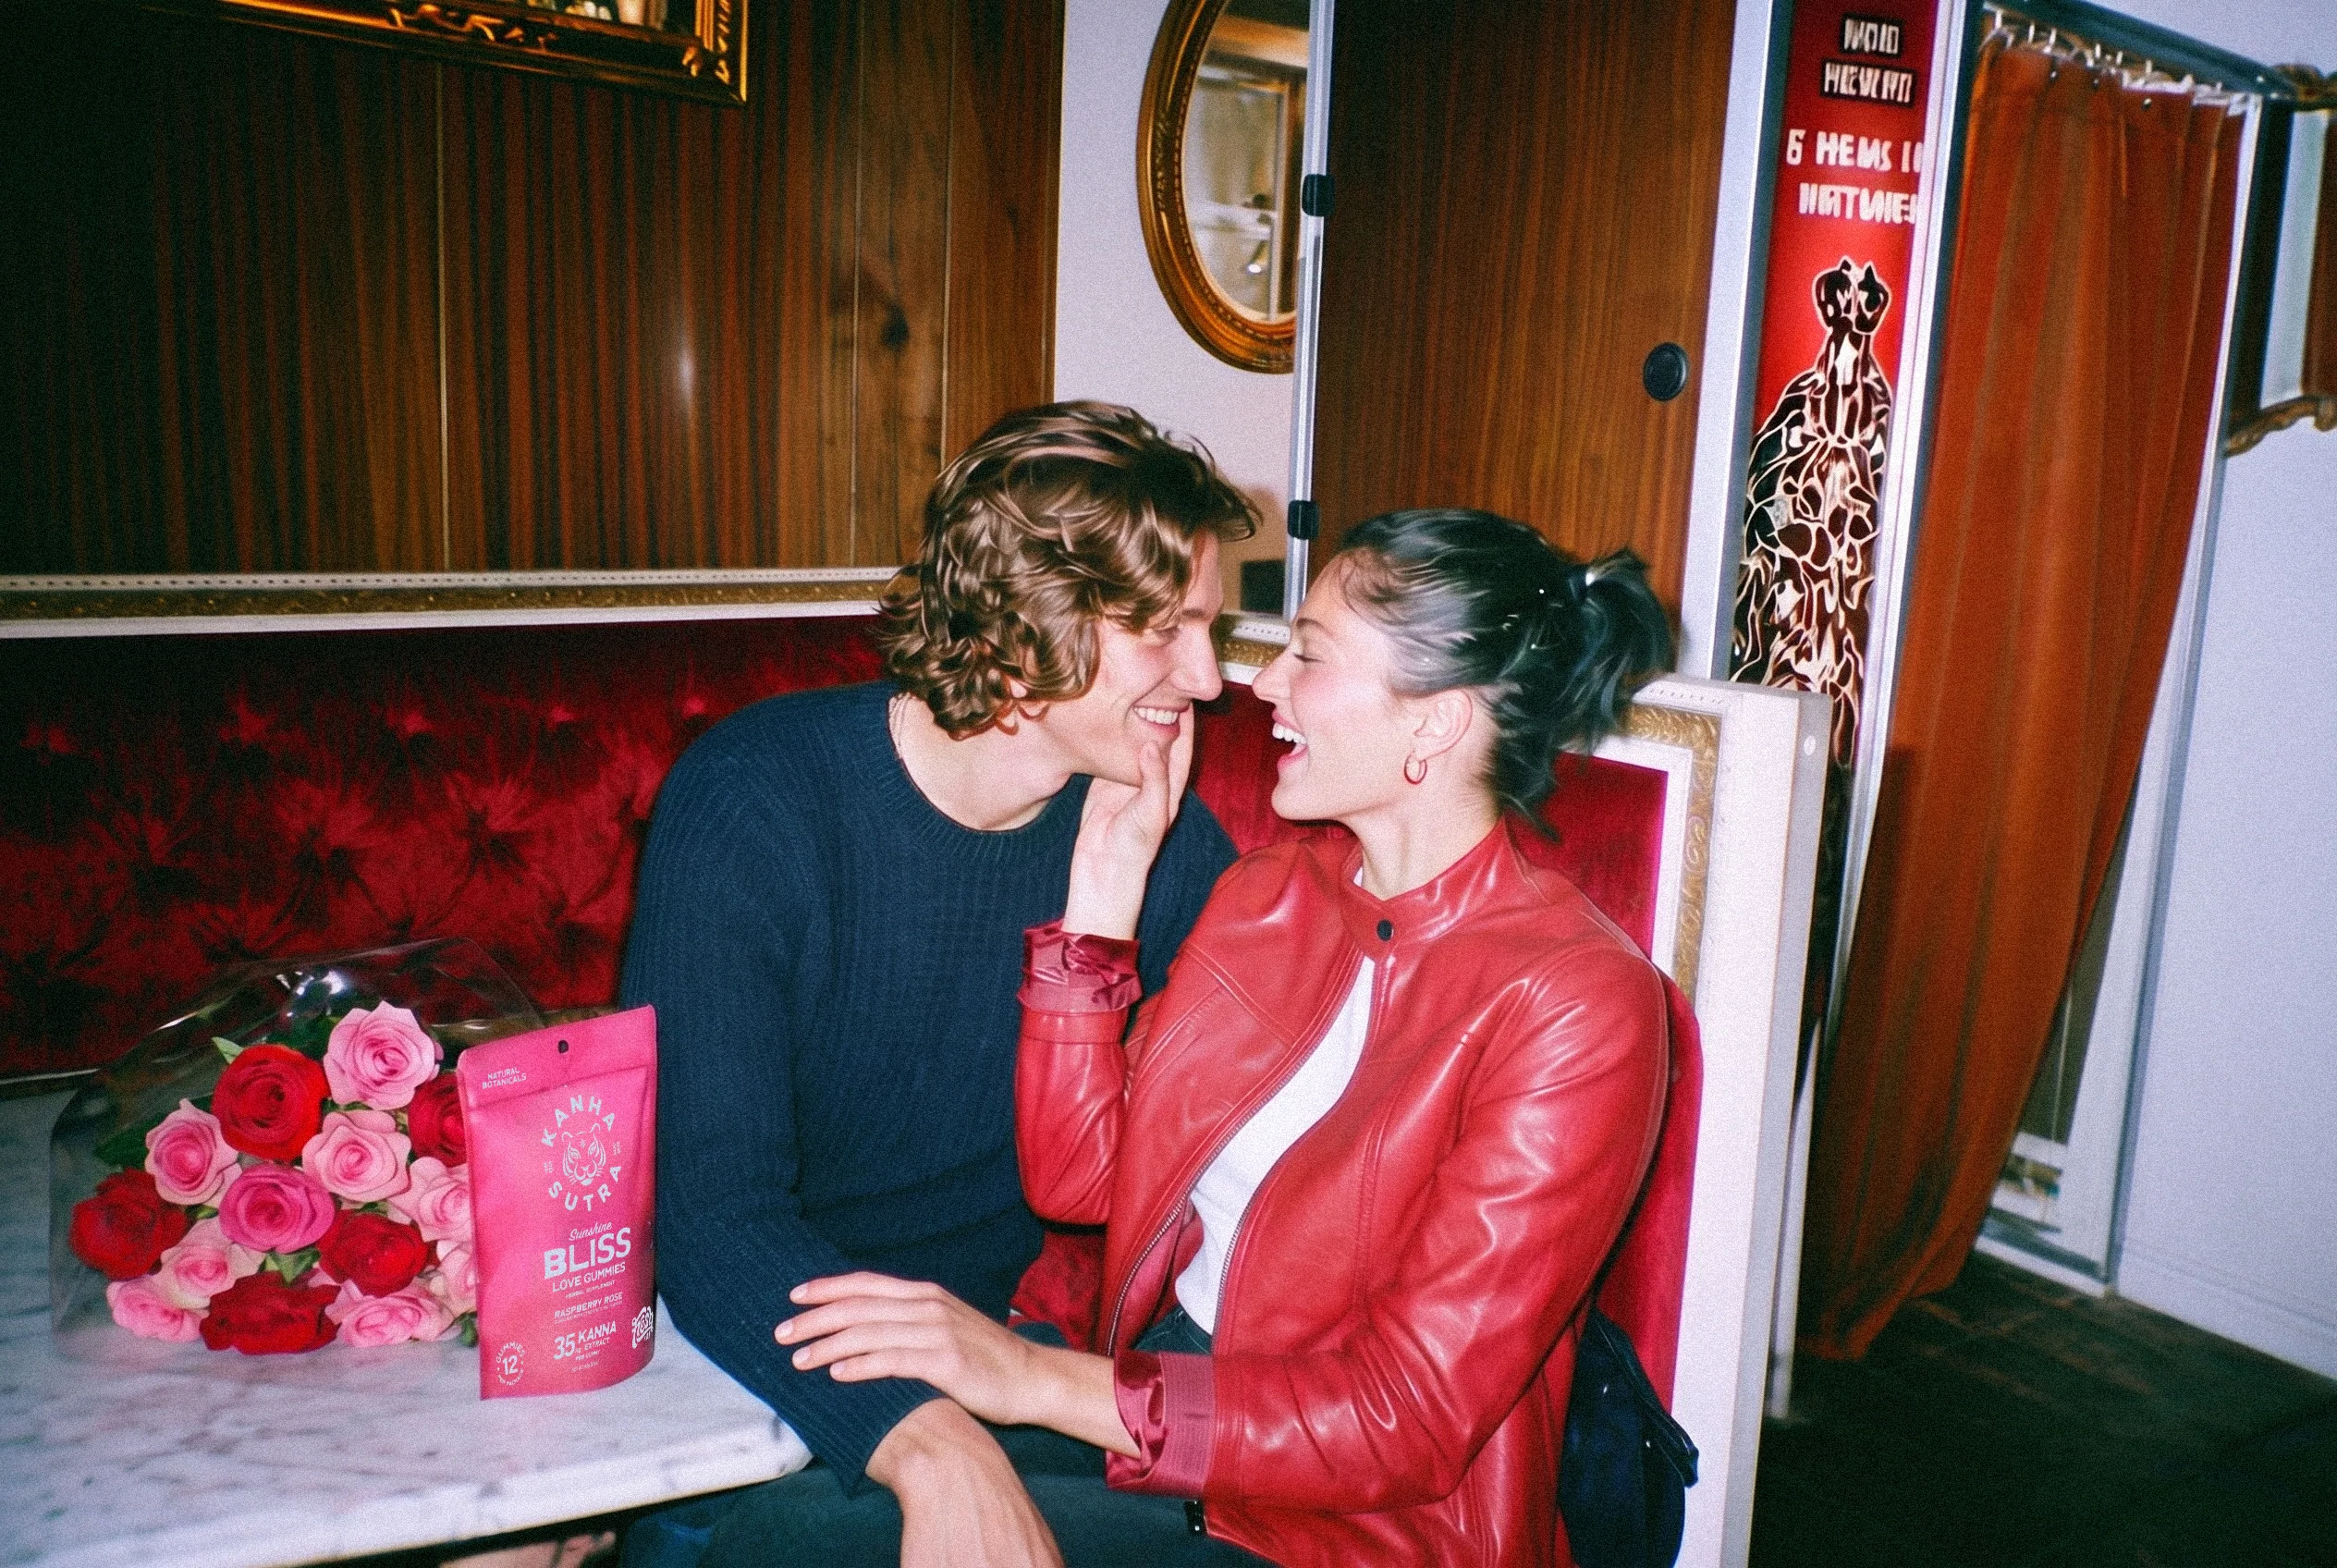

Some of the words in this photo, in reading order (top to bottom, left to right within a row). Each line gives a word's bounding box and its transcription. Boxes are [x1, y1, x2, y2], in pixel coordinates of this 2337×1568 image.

[482, 1072, 527, 1089] BOTANICALS
[487, 1066, 520, 1080] NATURAL
[541, 1095, 616, 1147] KANHA
[548, 1166, 621, 1211] SUTRA
[569, 1221, 612, 1241] Sunshine
[544, 1227, 631, 1280] BLISS
[552, 1275, 582, 1292] LOVE
[583, 1261, 626, 1283] GUMMIES
[555, 1297, 602, 1318] RASPBERRY
[604, 1292, 623, 1305] ROSE
[554, 1332, 576, 1360] 35
[578, 1320, 617, 1343] KANNA
[584, 1336, 611, 1351] EXTRACT
[496, 1341, 525, 1364] GUMMIES
[502, 1354, 518, 1376] 12
